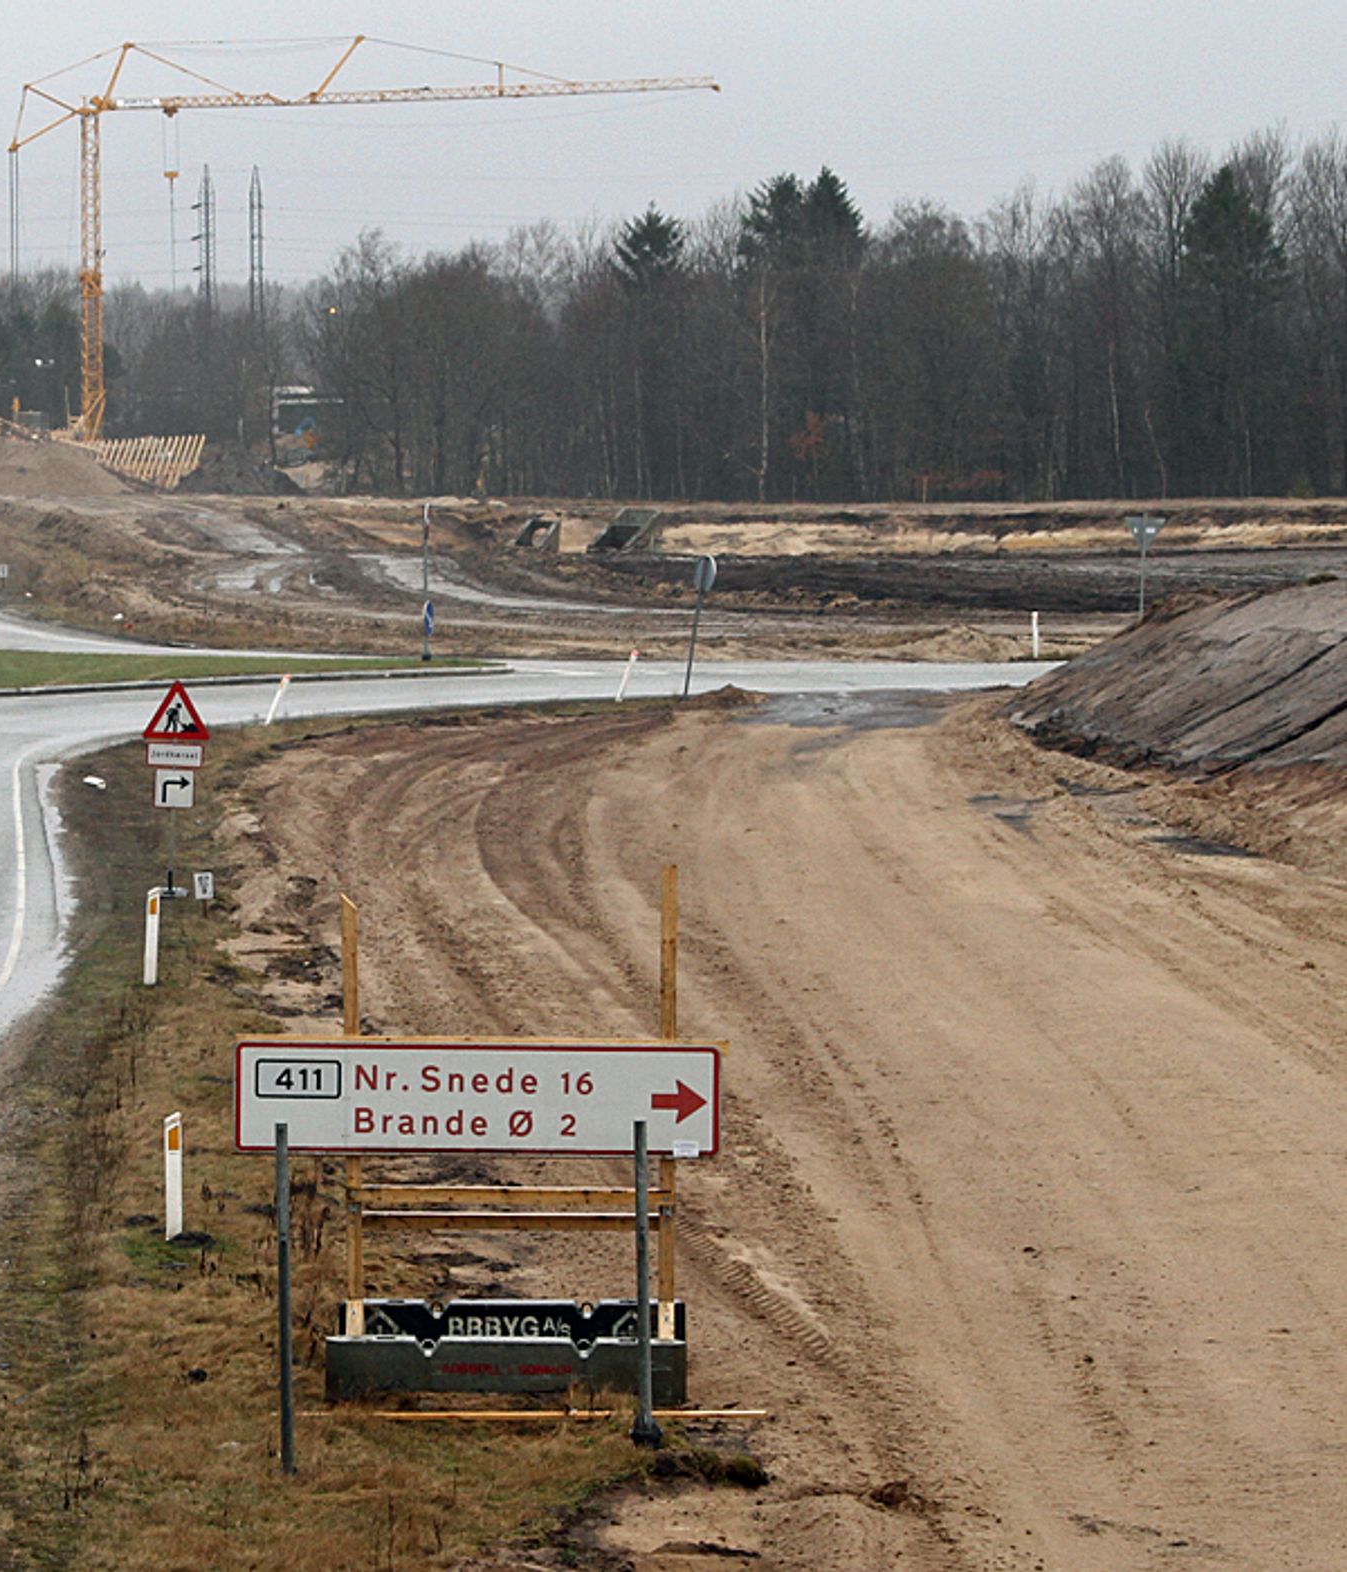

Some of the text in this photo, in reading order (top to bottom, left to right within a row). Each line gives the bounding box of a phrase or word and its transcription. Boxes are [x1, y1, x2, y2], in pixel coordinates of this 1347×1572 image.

[275, 1068, 322, 1091] 411
[354, 1064, 595, 1095] Nr. Snede 16
[354, 1106, 577, 1138] Brande Ø 2
